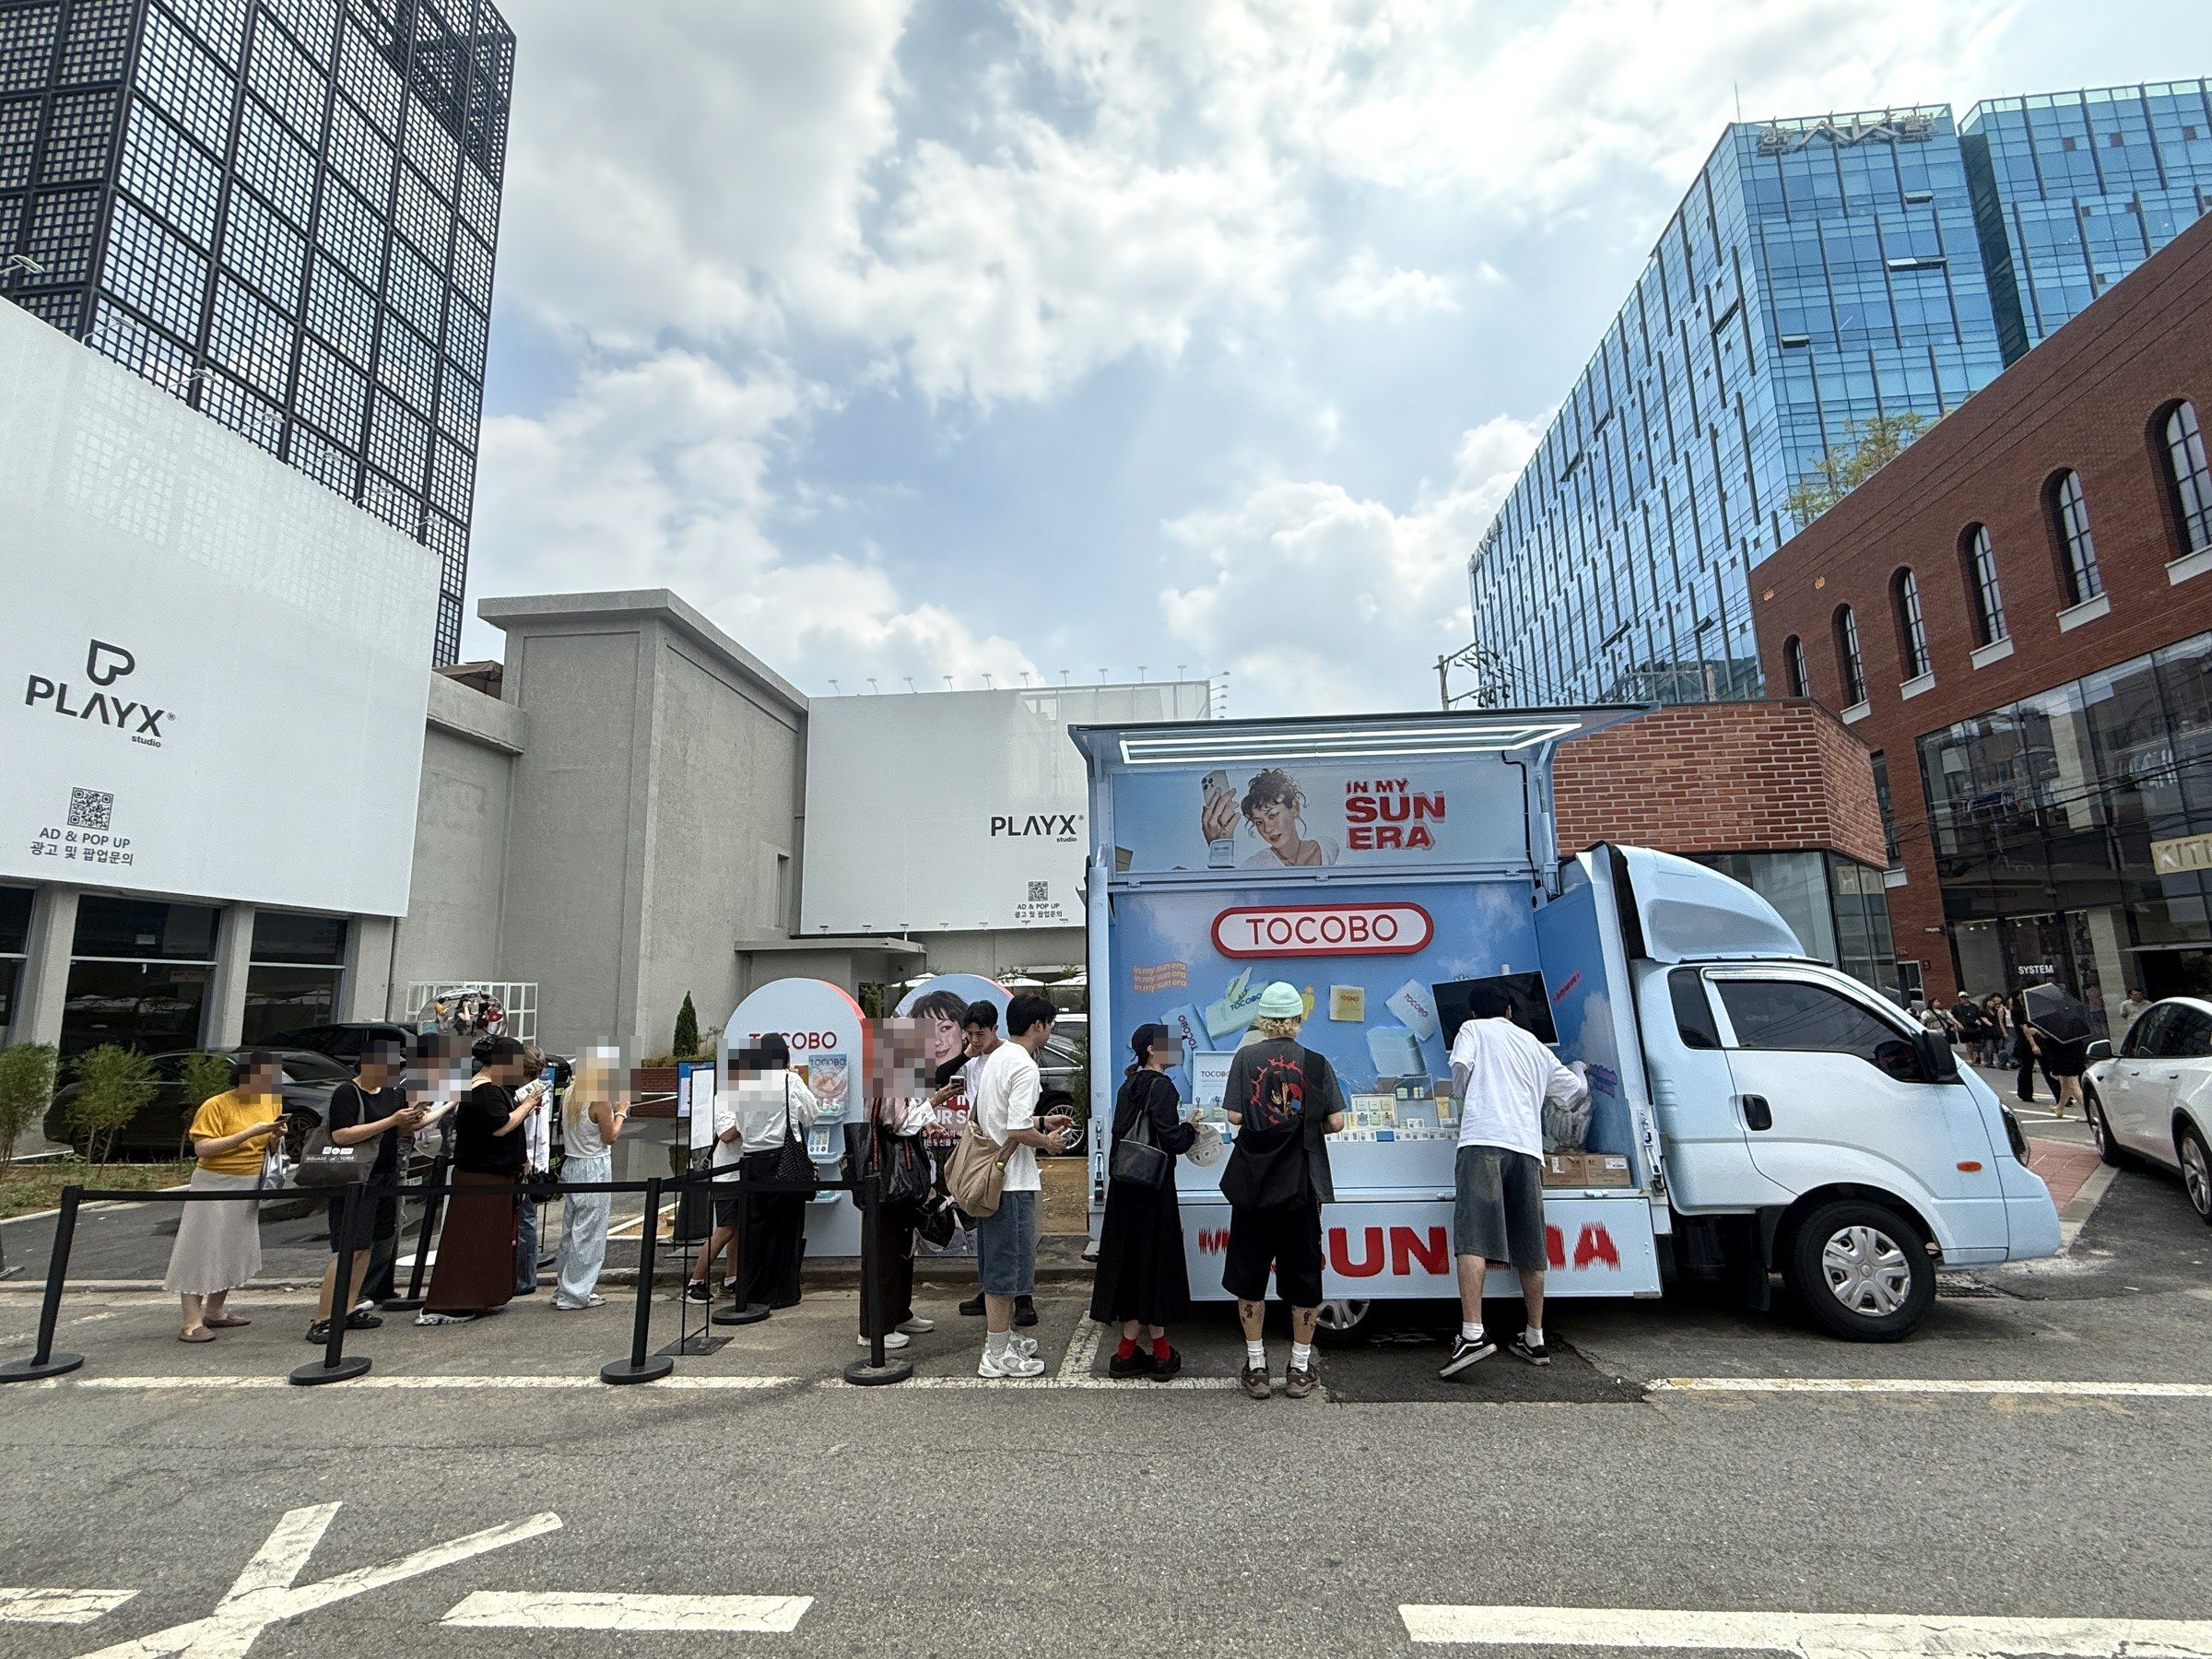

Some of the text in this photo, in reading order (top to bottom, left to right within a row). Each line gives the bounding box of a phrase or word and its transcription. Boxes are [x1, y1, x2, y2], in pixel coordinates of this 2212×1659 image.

[26, 675, 164, 737] PLAYX
[132, 735, 161, 748] studio
[1347, 778, 1409, 794] IN MY
[1346, 791, 1445, 823] SUN
[991, 815, 1077, 836] PLAYX
[39, 828, 131, 849] AD & POP UP
[1347, 825, 1436, 851] ERA
[30, 841, 134, 865] 광고 및 팝업문의
[1246, 914, 1398, 945] TOCOBO
[2018, 965, 2053, 974] SYSTEM
[1230, 992, 1263, 1011] TOCOBO
[1404, 993, 1429, 1018] TOCOBO
[809, 1057, 846, 1066] TOCOBO
[1319, 1225, 1449, 1277] UN
